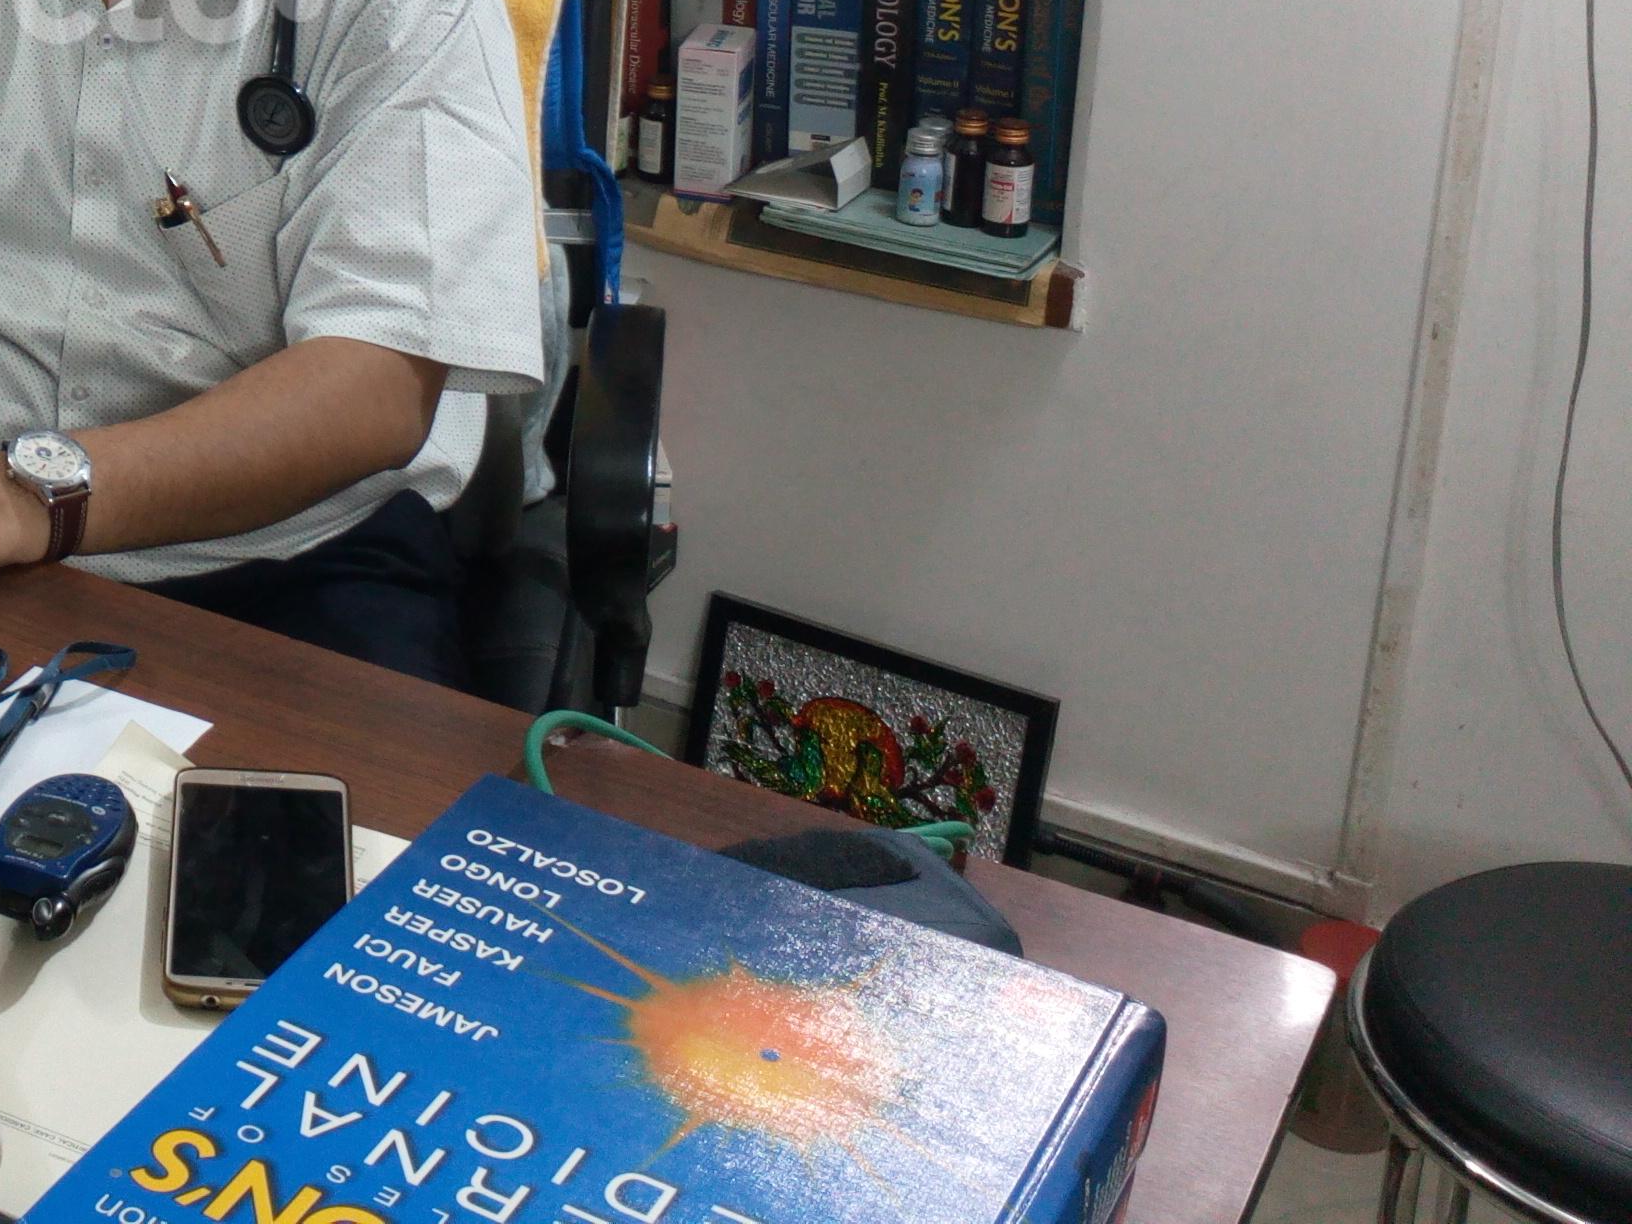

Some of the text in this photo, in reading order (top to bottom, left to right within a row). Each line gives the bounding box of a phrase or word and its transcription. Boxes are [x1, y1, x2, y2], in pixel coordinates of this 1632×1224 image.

[982, 3, 995, 54] MEDICINE
[440, 854, 563, 909] LONGO
[466, 828, 647, 905] LOSCALZO
[384, 905, 525, 972] KASPER
[412, 878, 555, 944] HAUSER
[353, 933, 463, 988] FAUCI
[323, 962, 500, 1043] JAMESON
